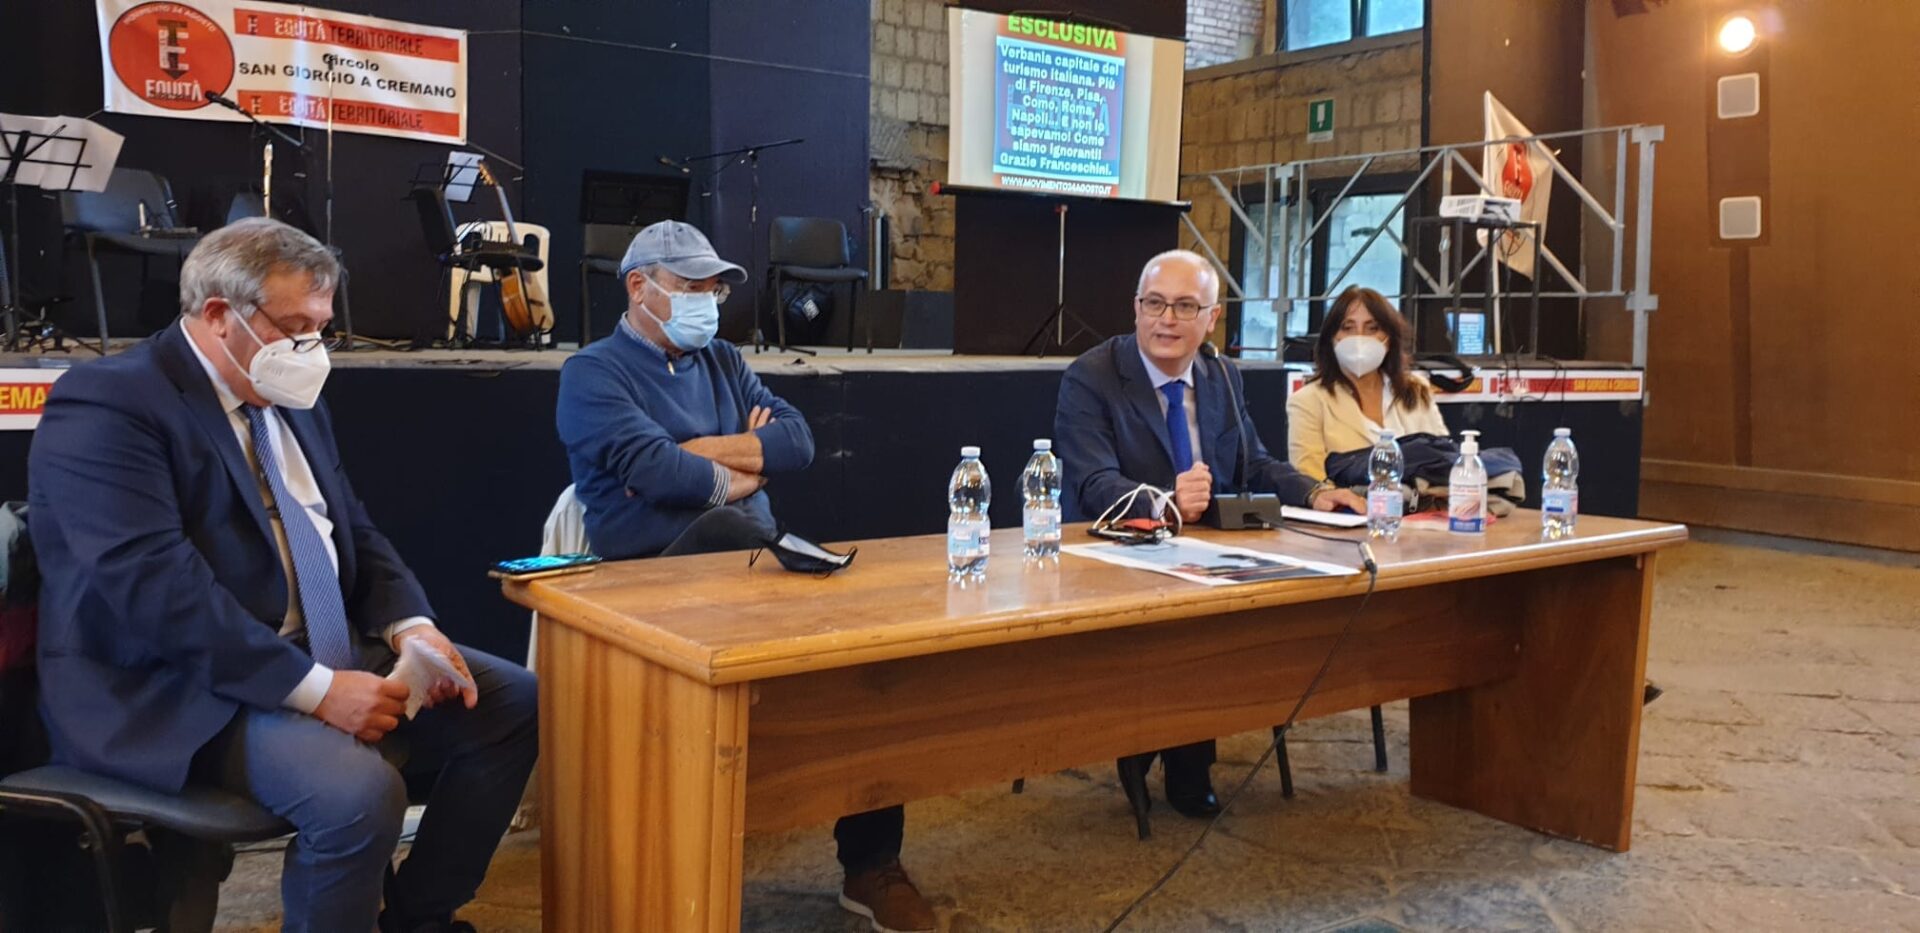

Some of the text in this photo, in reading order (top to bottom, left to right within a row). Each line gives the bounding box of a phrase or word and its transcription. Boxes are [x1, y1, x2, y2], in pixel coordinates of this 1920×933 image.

[330, 25, 424, 55] TERRITORIALE
[1008, 15, 1117, 51] ESCLUSIVA
[322, 53, 379, 72] Circolo
[1000, 45, 1052, 64] Verbania
[1054, 55, 1100, 73] capitale
[239, 61, 456, 99] SAN GIORGIO A CREMANO
[1003, 60, 1116, 90] turismo italiana. Più
[1015, 78, 1103, 104] di Firenze, Pisa,
[331, 103, 424, 129] TERRITORIALE
[1022, 95, 1096, 118] Como, Roma,
[1011, 108, 1105, 132] Napoli... E non lo
[1013, 139, 1102, 161] siamo ignoranti!
[1074, 131, 1105, 147] Come
[1000, 152, 1112, 175] Grazie Franceschini.
